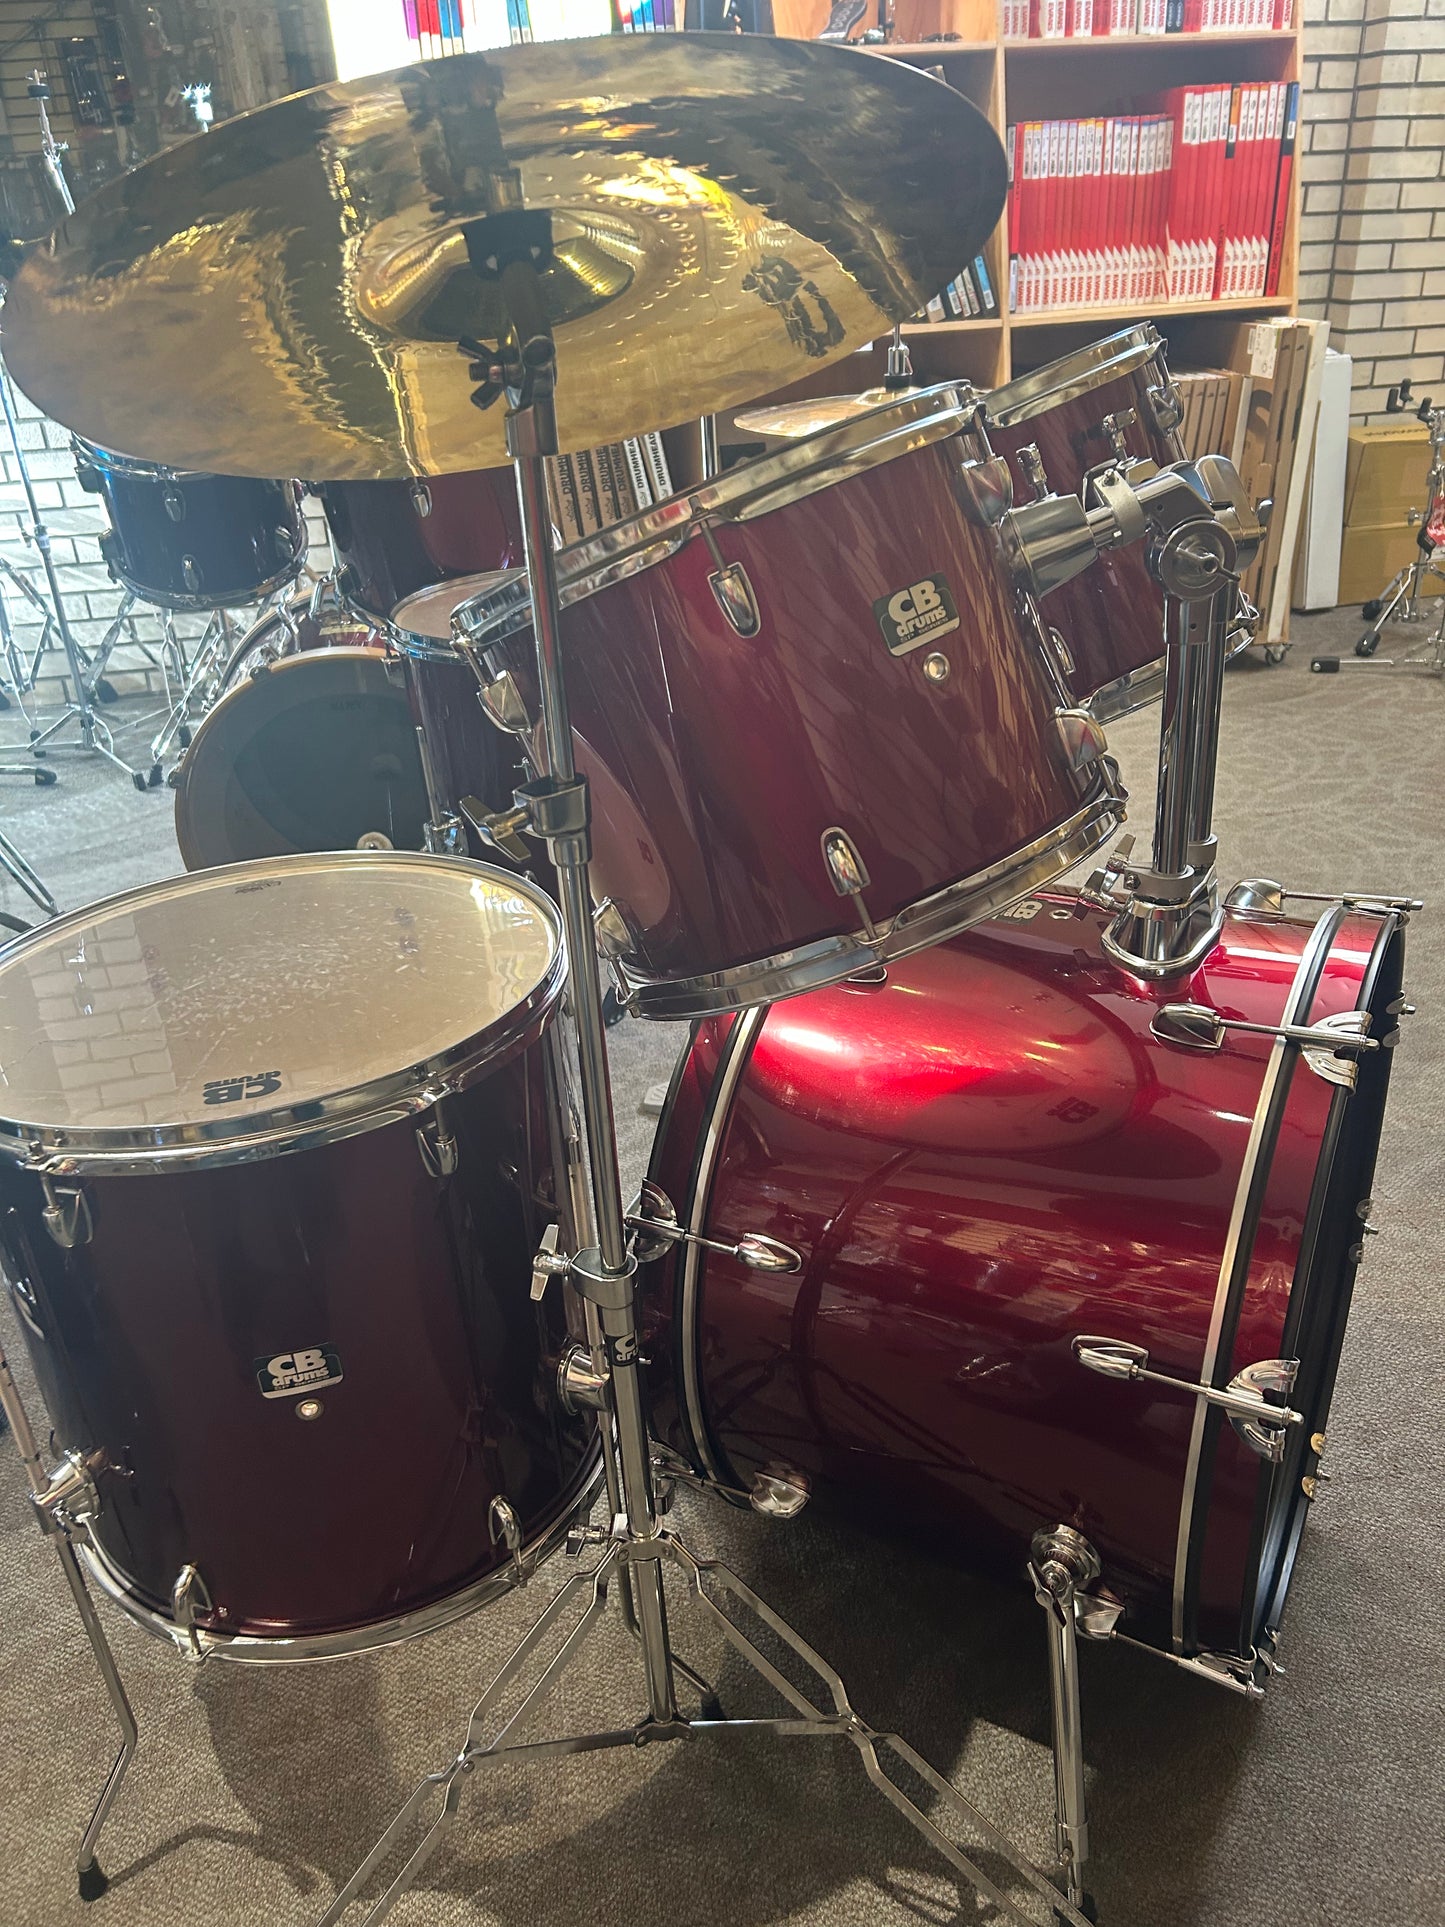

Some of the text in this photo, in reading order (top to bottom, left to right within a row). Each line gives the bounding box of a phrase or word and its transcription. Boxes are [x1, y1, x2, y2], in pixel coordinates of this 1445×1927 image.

[626, 439, 645, 489] DRUMHEA
[648, 432, 667, 486] DRUMHEAD
[887, 580, 942, 624] CB
[896, 605, 948, 637] drums
[202, 1078, 282, 1105] CB
[203, 1070, 282, 1090] drums
[615, 1329, 638, 1353] C
[267, 1348, 327, 1378] CB
[271, 1366, 330, 1387] drums
